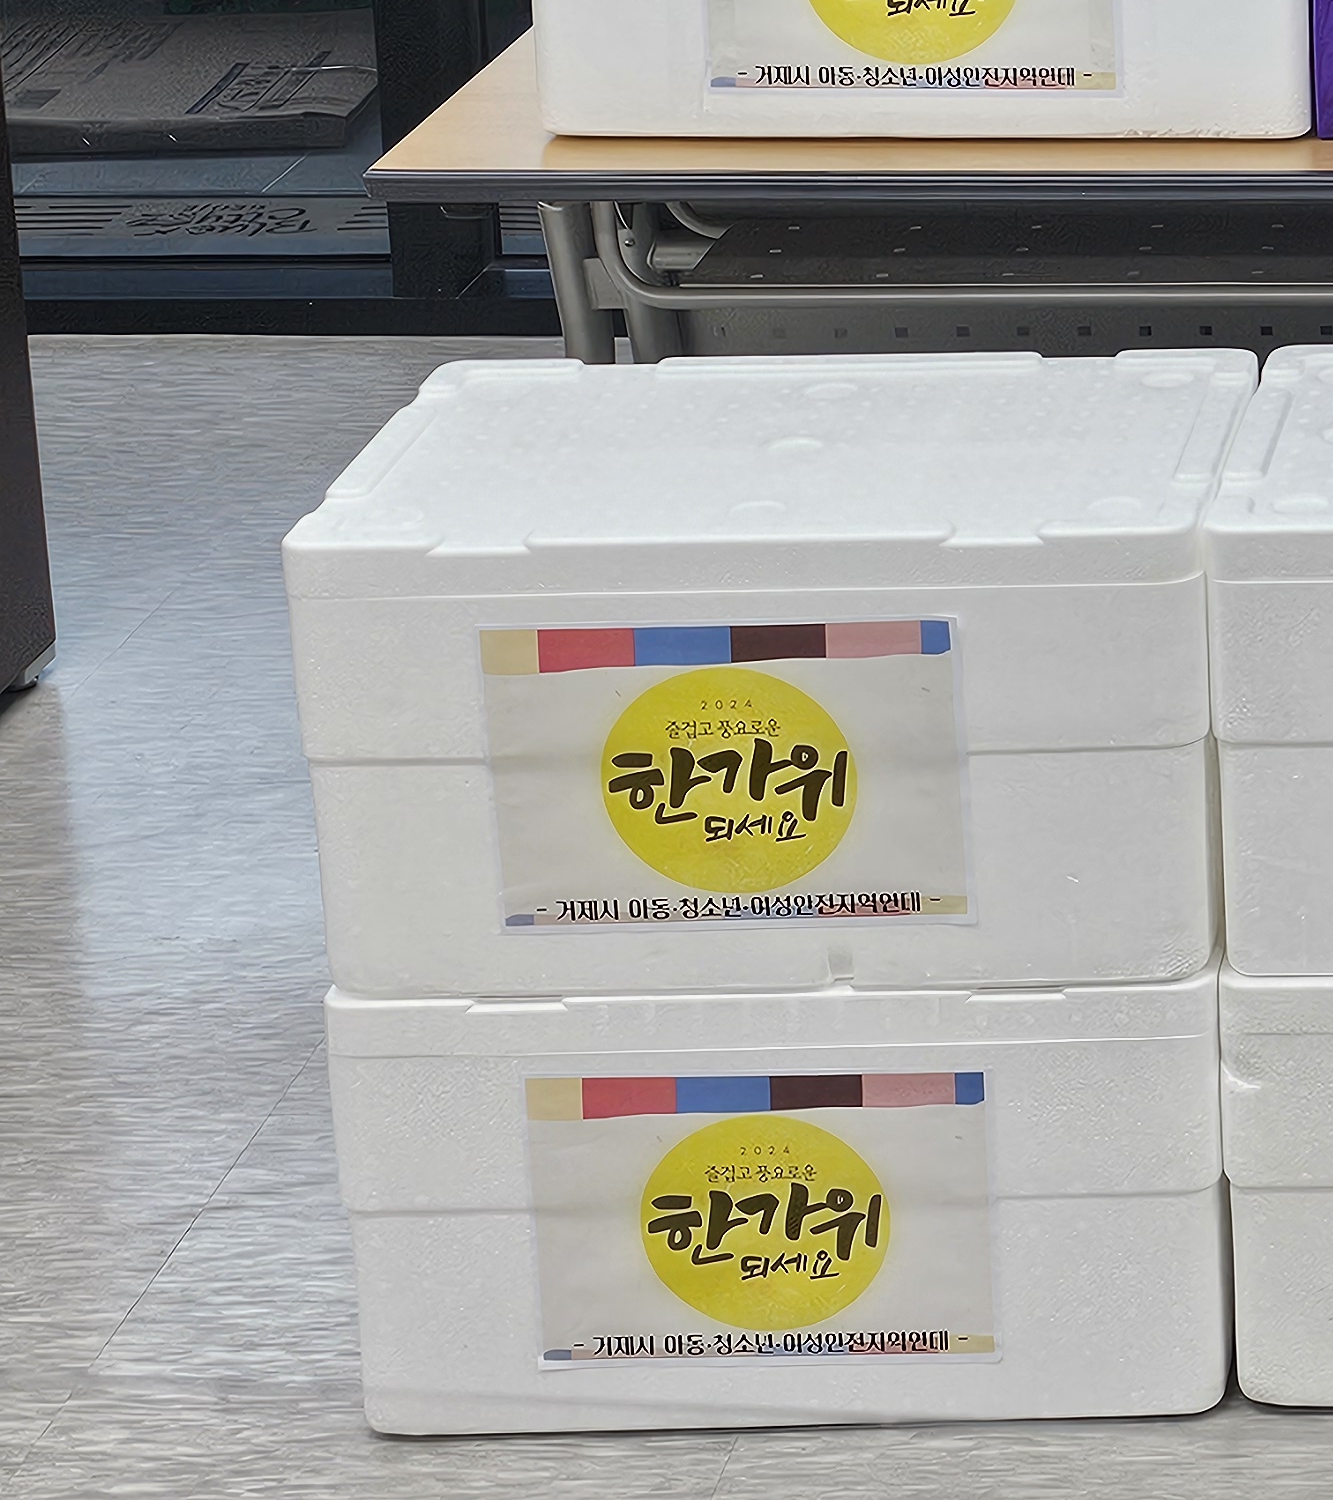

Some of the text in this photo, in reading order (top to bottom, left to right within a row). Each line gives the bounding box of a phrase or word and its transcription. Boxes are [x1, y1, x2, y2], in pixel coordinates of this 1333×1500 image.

[754, 65, 810, 85] 거제시
[700, 700, 752, 711] 2024
[608, 738, 848, 824] 한가위
[705, 812, 807, 842] 되세요
[556, 898, 619, 921] 거제시
[740, 1146, 790, 1156] 2024
[648, 1183, 882, 1265] 한가위
[741, 1251, 840, 1280] 되세요
[593, 1335, 655, 1357] 거제시
